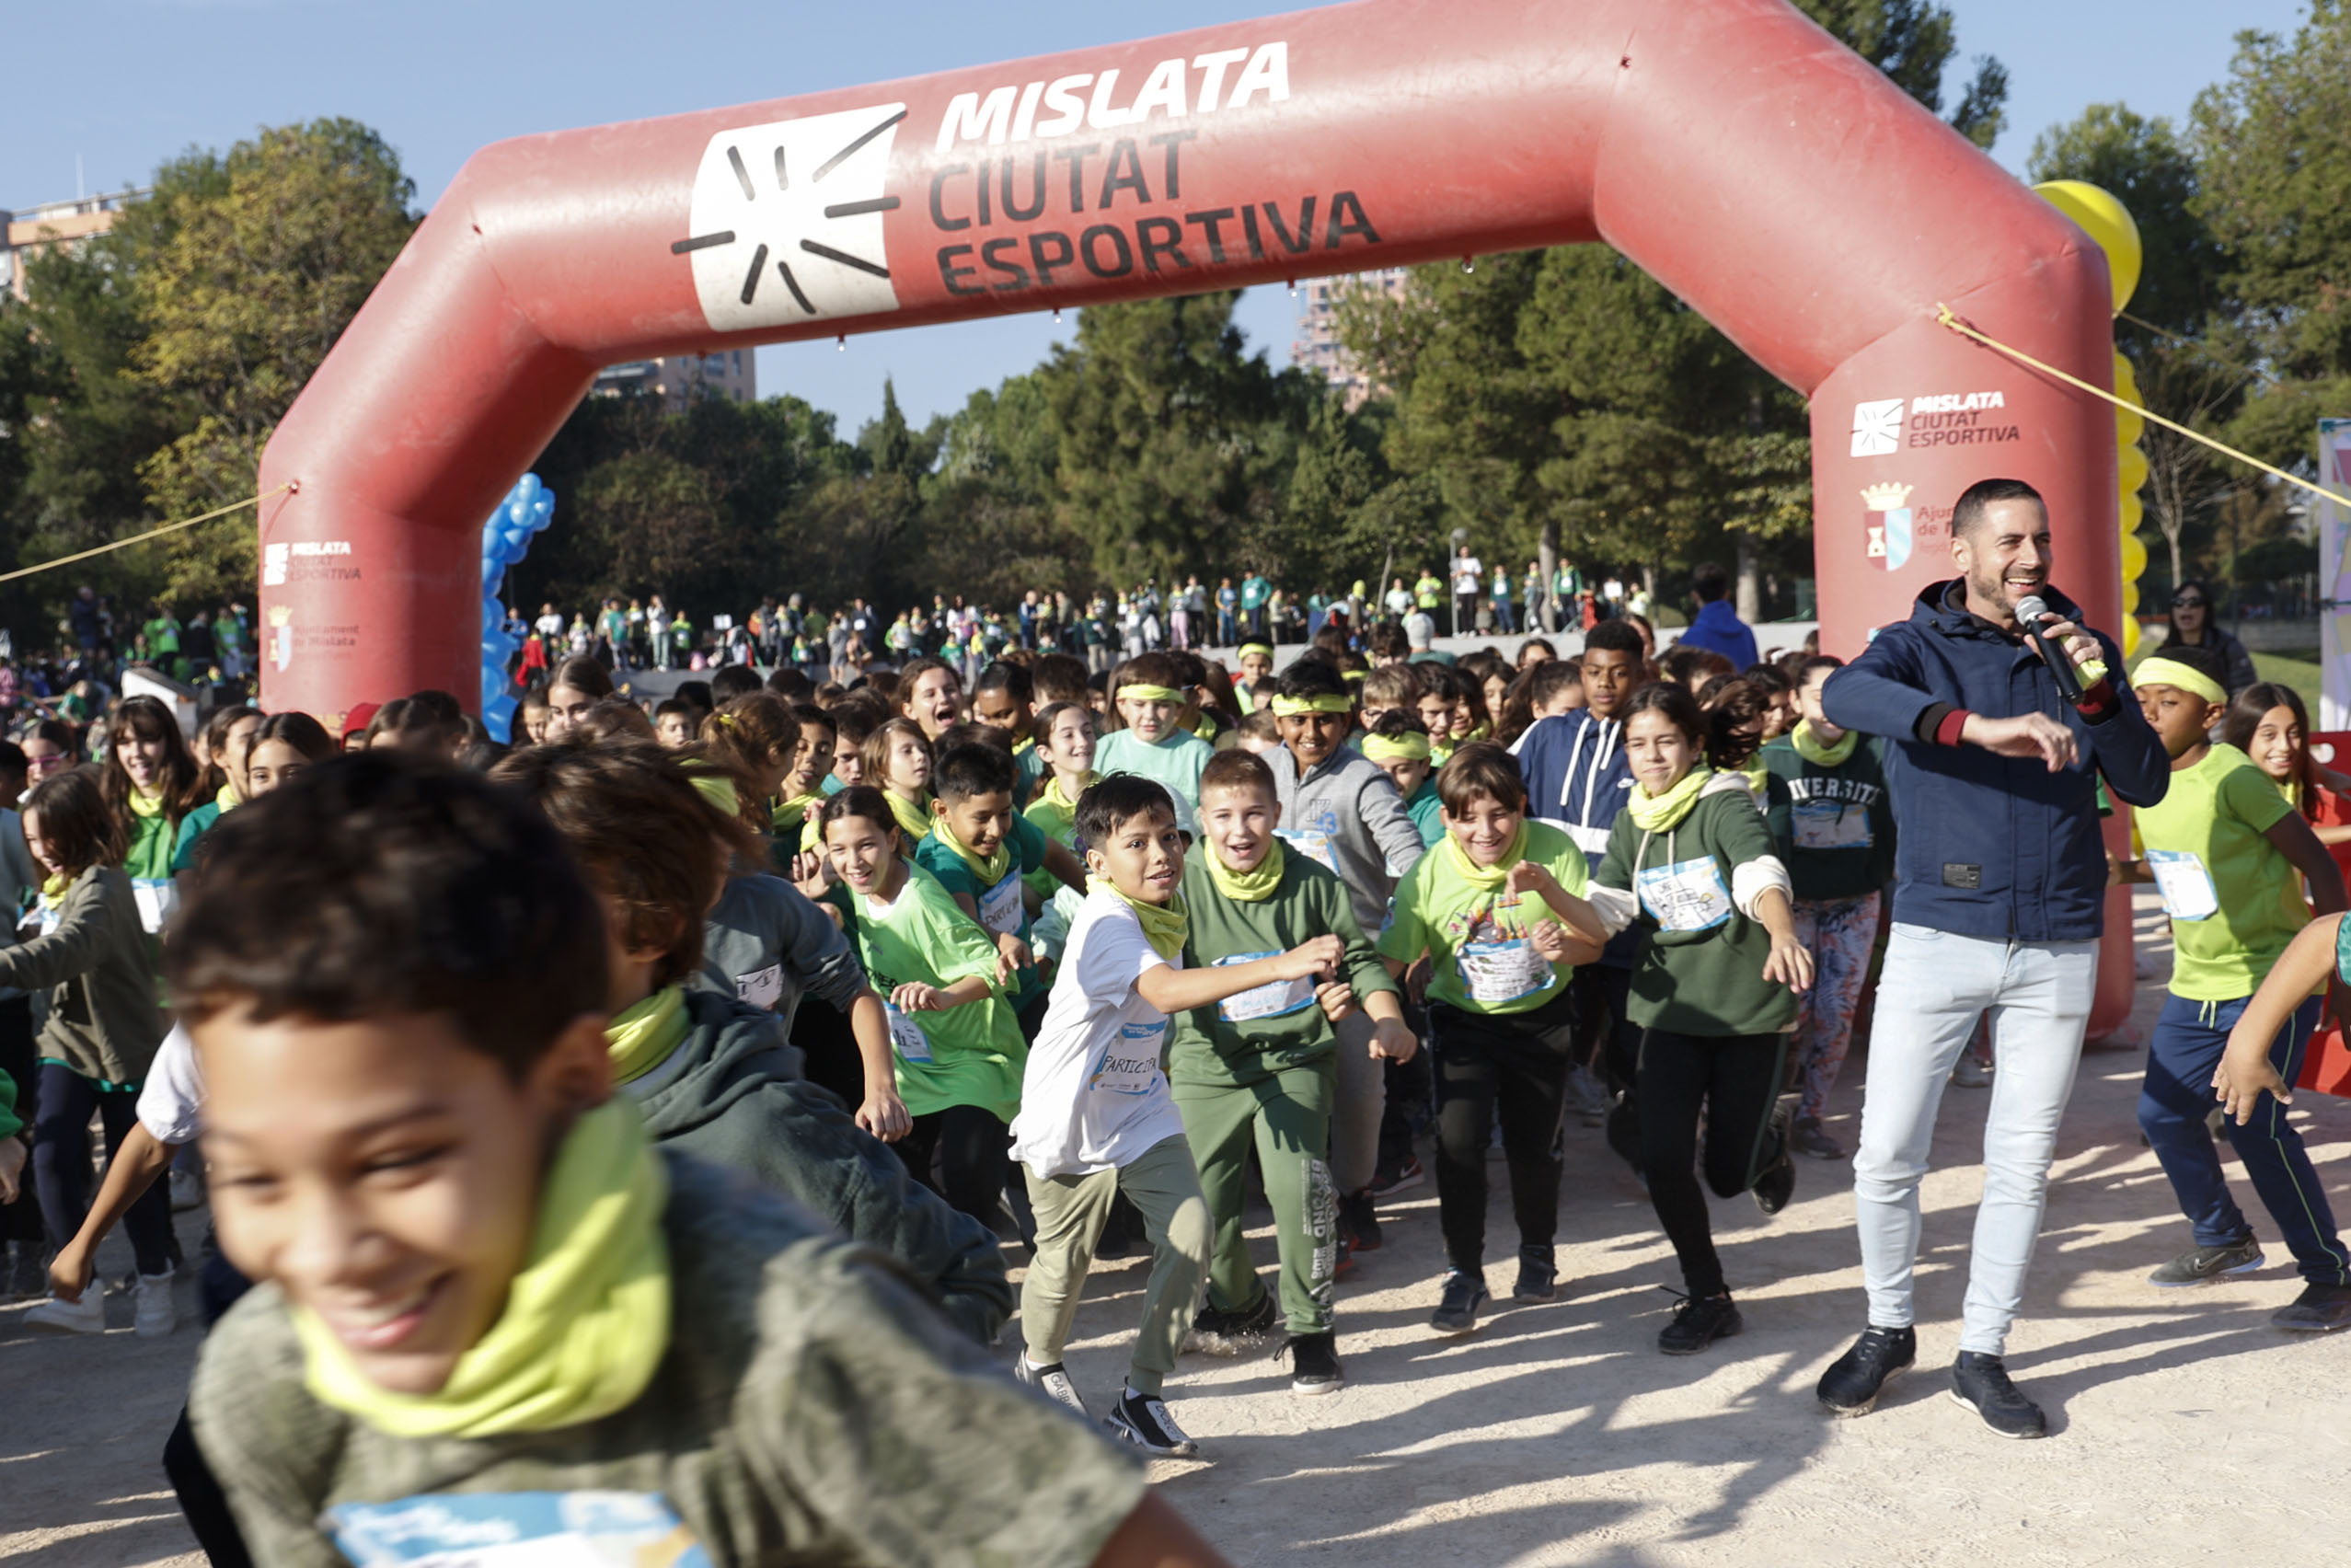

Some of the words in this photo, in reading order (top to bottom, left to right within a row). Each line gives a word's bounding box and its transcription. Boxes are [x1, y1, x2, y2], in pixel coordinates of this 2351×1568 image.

[935, 41, 1290, 155] MISLATA
[929, 130, 1197, 232] CIUTAT
[936, 190, 1381, 296] ESPORTIVA
[1909, 411, 1981, 432] CIUTAT
[1911, 391, 2005, 415] MISLATA
[1908, 425, 2021, 448] ESPORTIVA
